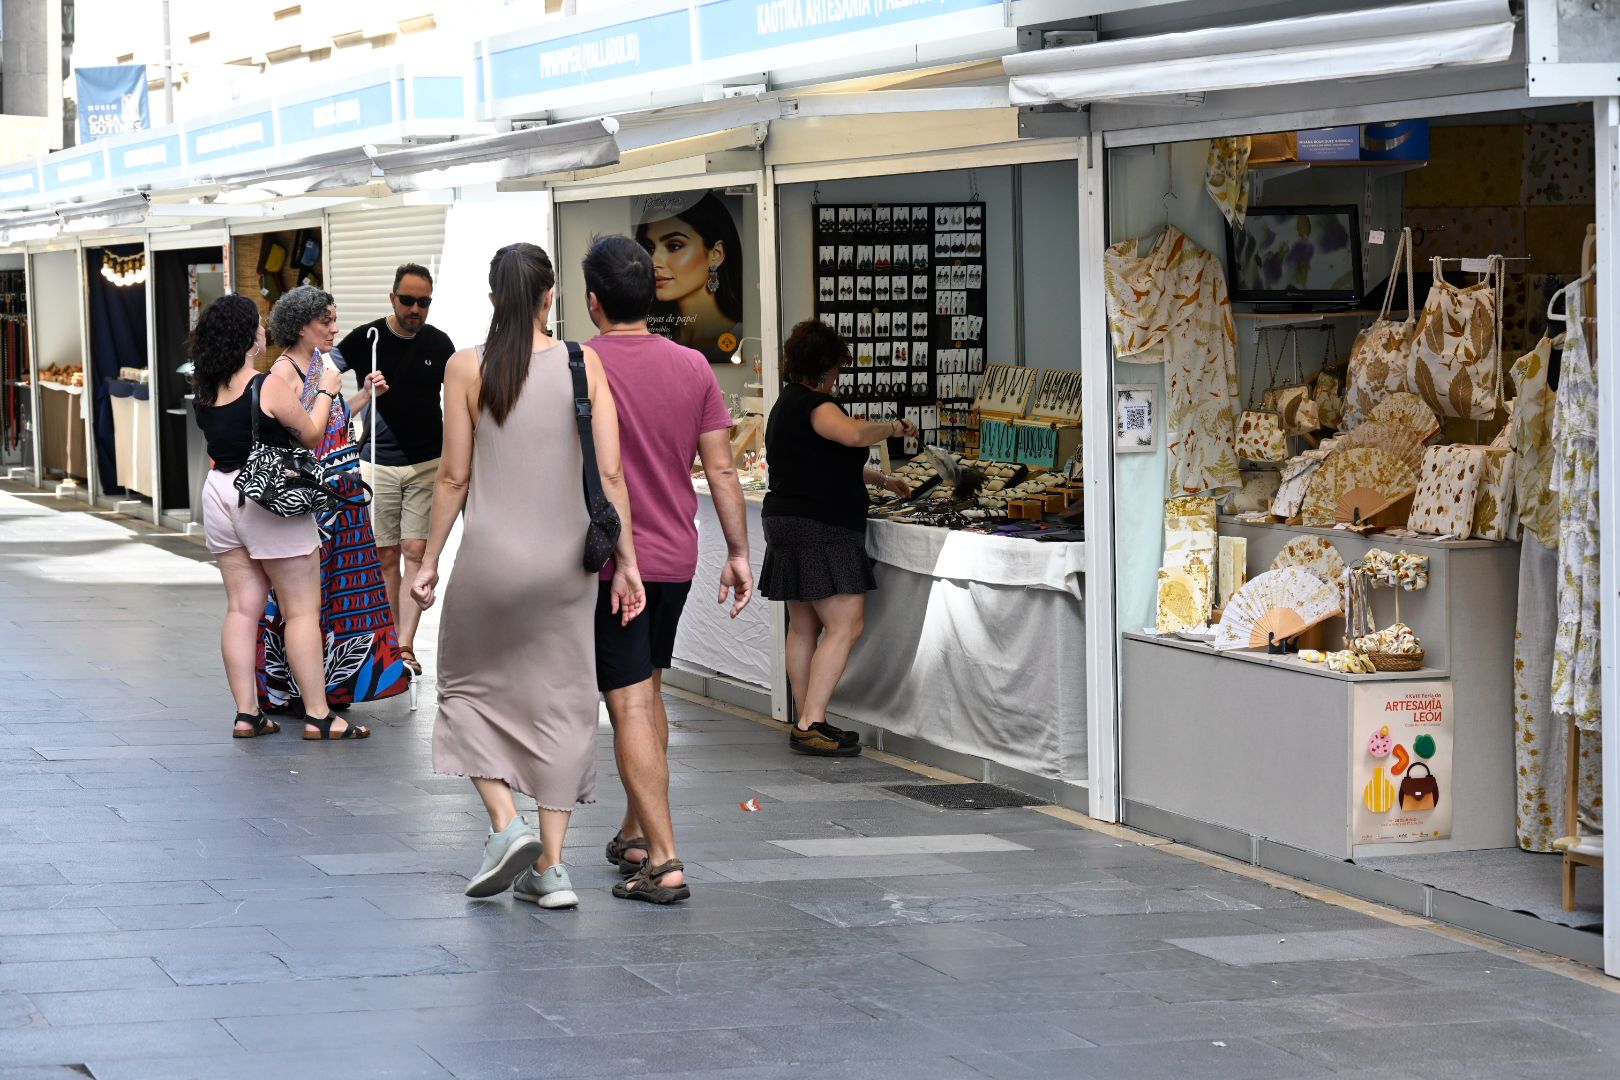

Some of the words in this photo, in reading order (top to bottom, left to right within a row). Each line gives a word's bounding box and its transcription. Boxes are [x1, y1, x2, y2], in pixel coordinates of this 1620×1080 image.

[88, 114, 121, 124] CASA
[665, 313, 676, 323] de
[675, 313, 698, 326] papel
[1384, 698, 1443, 711] ARTESANÍA
